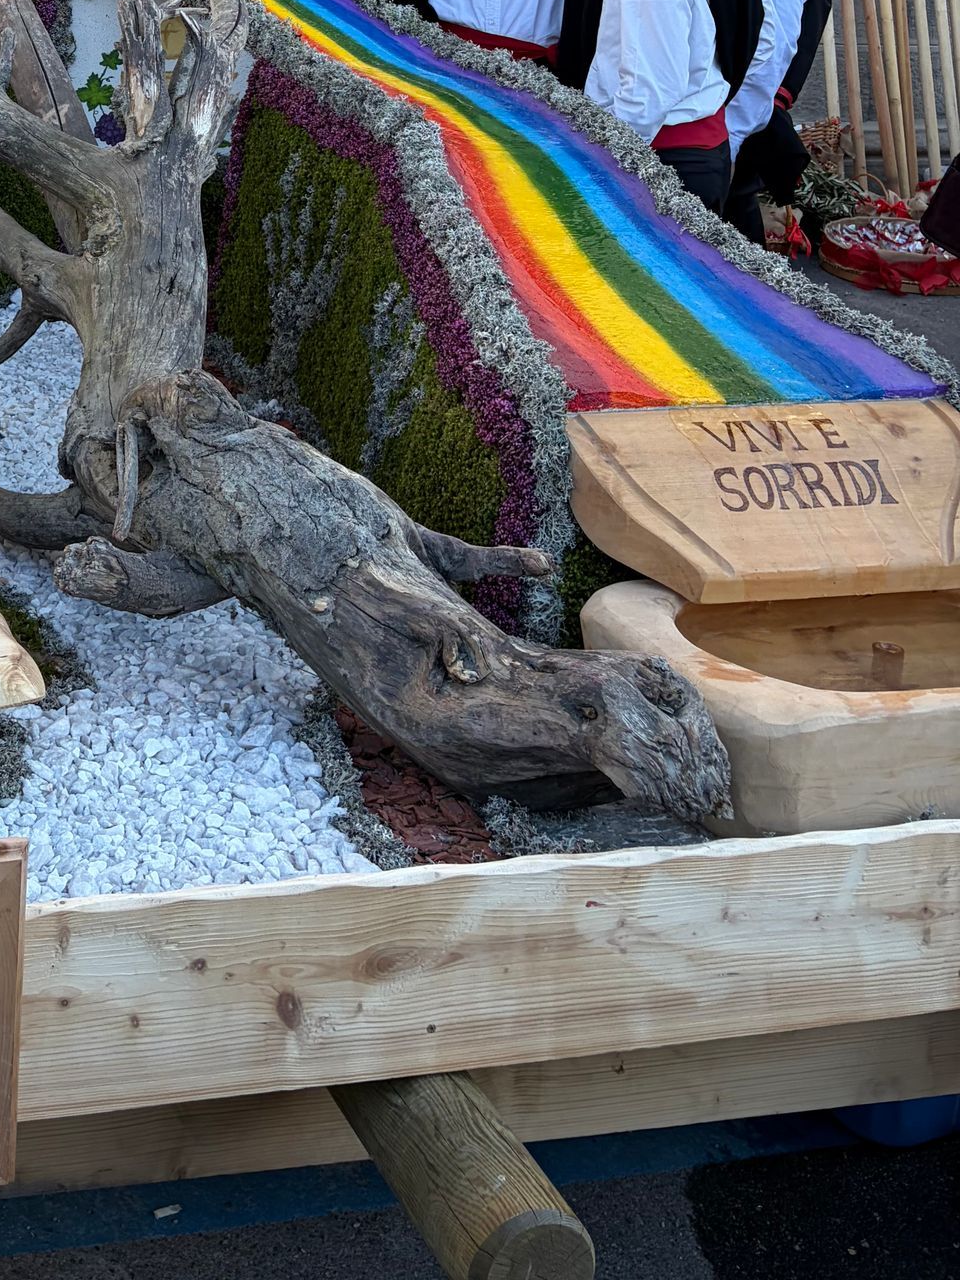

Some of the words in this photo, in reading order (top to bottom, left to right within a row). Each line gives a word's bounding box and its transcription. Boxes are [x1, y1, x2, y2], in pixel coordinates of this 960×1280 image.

[691, 419, 809, 452] VIVI
[807, 418, 850, 449] E
[713, 459, 899, 512] SORRIDI
